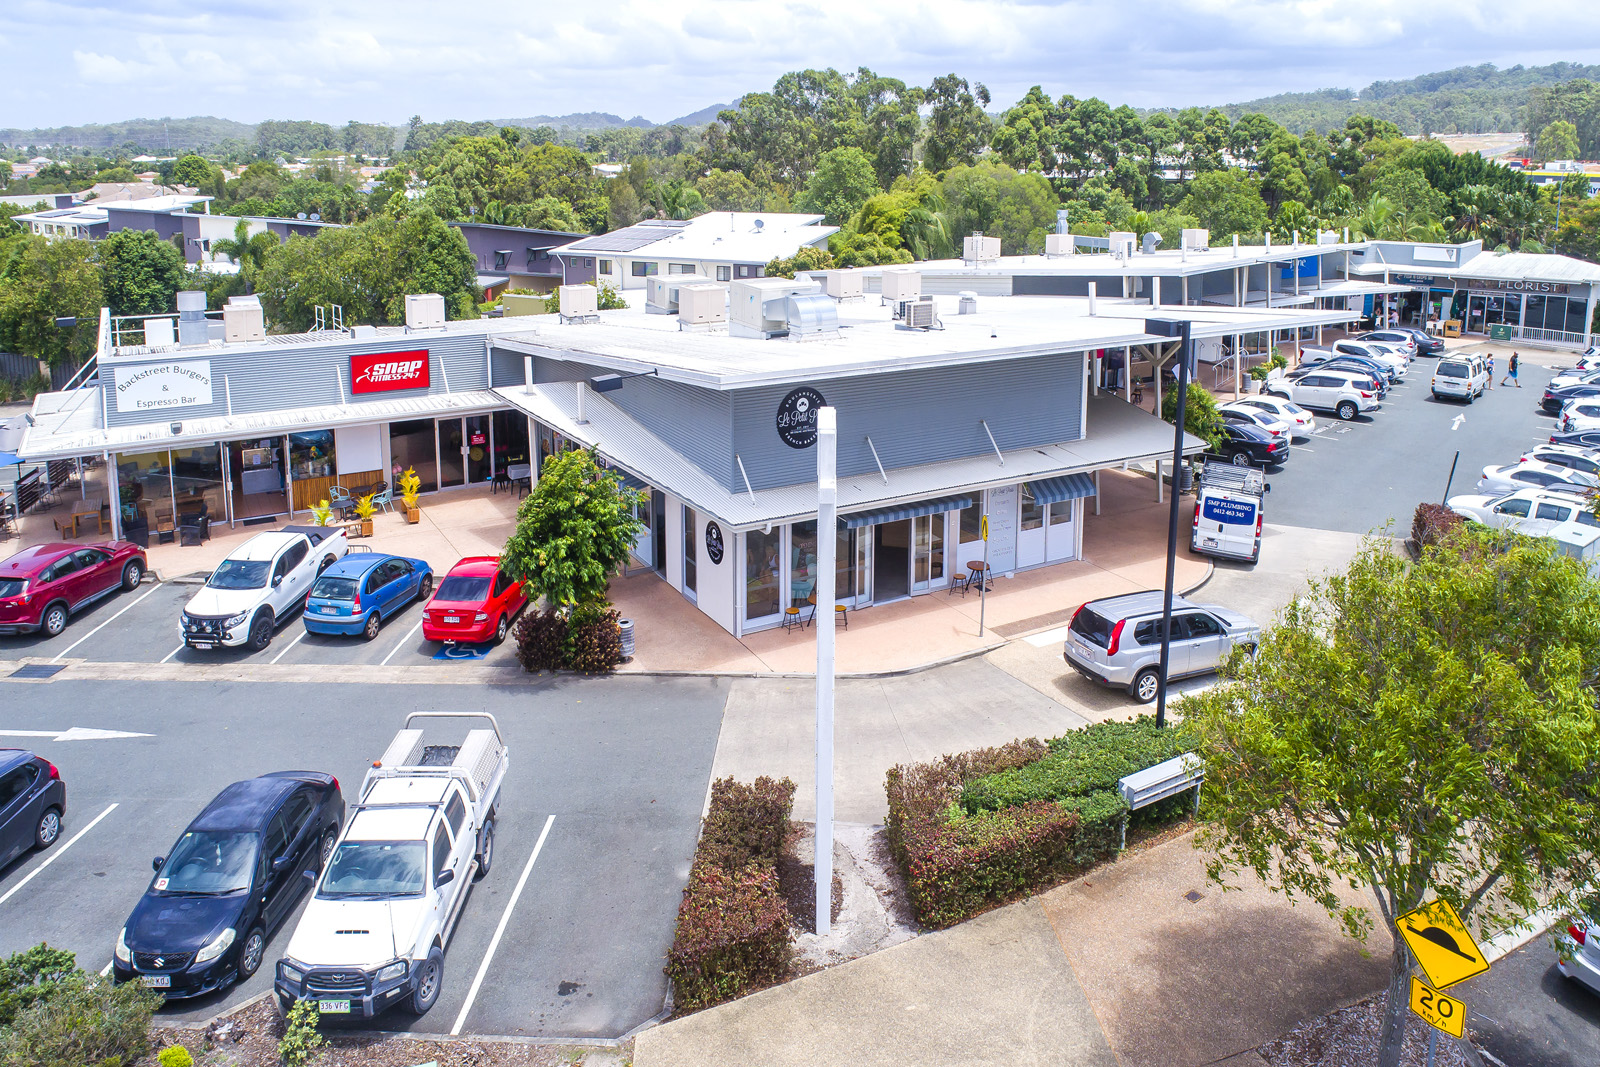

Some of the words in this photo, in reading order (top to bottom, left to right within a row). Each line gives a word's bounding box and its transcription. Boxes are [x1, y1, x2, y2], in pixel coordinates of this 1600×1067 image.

[1498, 280, 1560, 292] FLORIST
[118, 366, 170, 393] Backstreet
[173, 365, 210, 385] Burgers
[161, 384, 170, 392] &
[136, 397, 178, 409] Espresso
[181, 396, 197, 404] Bar
[1213, 507, 1225, 515] 0412
[1220, 501, 1252, 512] PLUMBING
[1420, 987, 1453, 1018] 20
[1422, 1009, 1447, 1028] km/h
